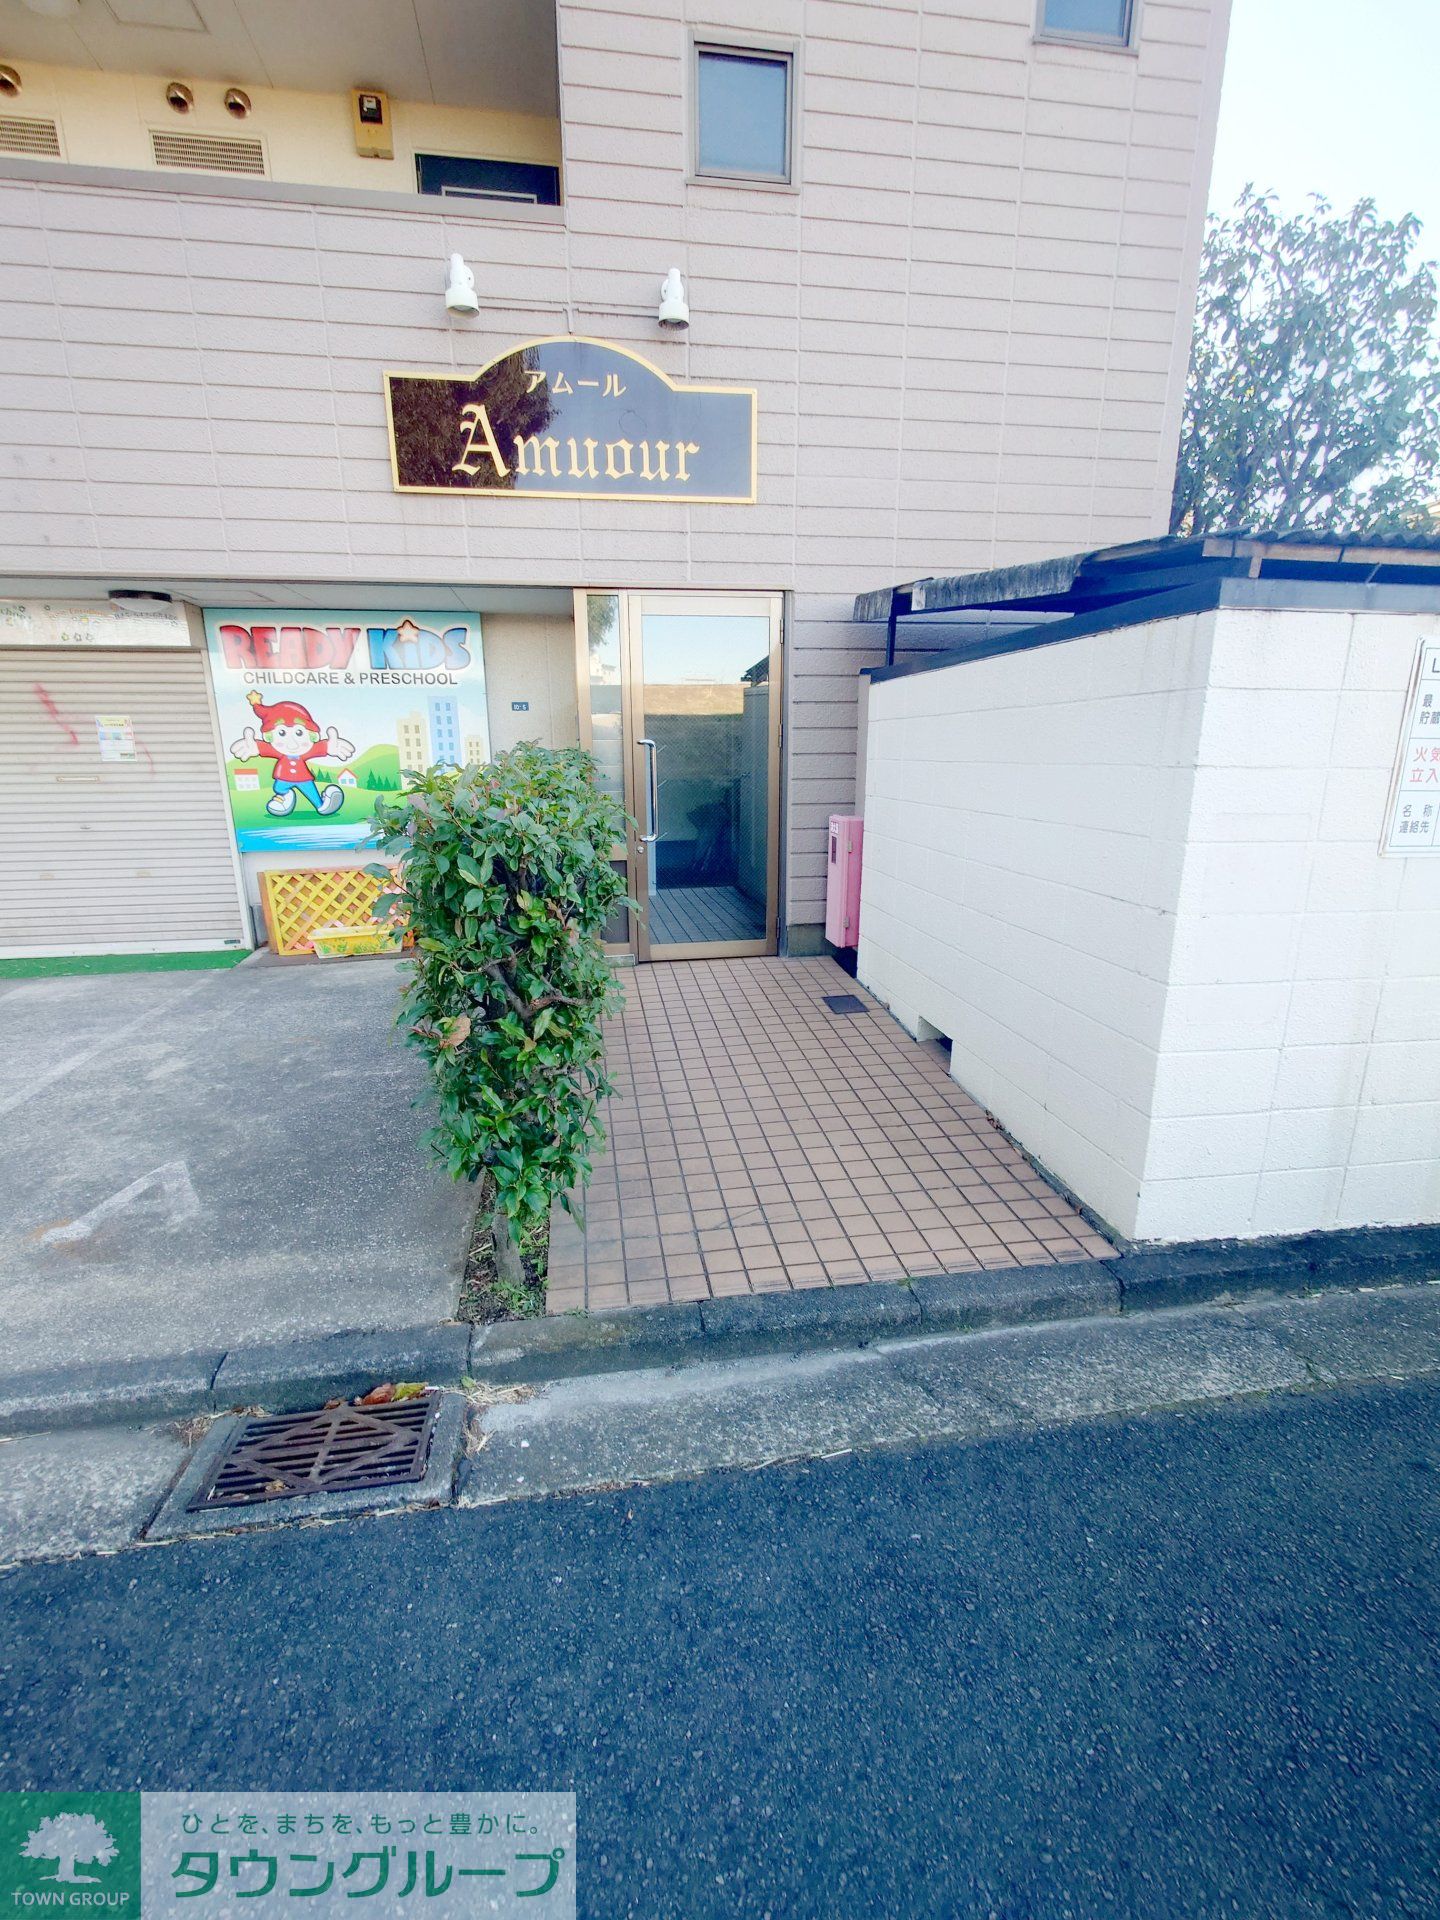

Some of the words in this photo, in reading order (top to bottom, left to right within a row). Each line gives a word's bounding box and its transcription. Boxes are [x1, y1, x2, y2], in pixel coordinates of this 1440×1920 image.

[523, 369, 628, 398] アムール
[451, 402, 701, 481] Amuour
[219, 625, 361, 670] READY
[243, 672, 340, 685] CHILDCARE
[343, 673, 355, 685] &
[359, 672, 458, 686] PRESCHOOL
[1399, 820, 1430, 834] 連絡先
